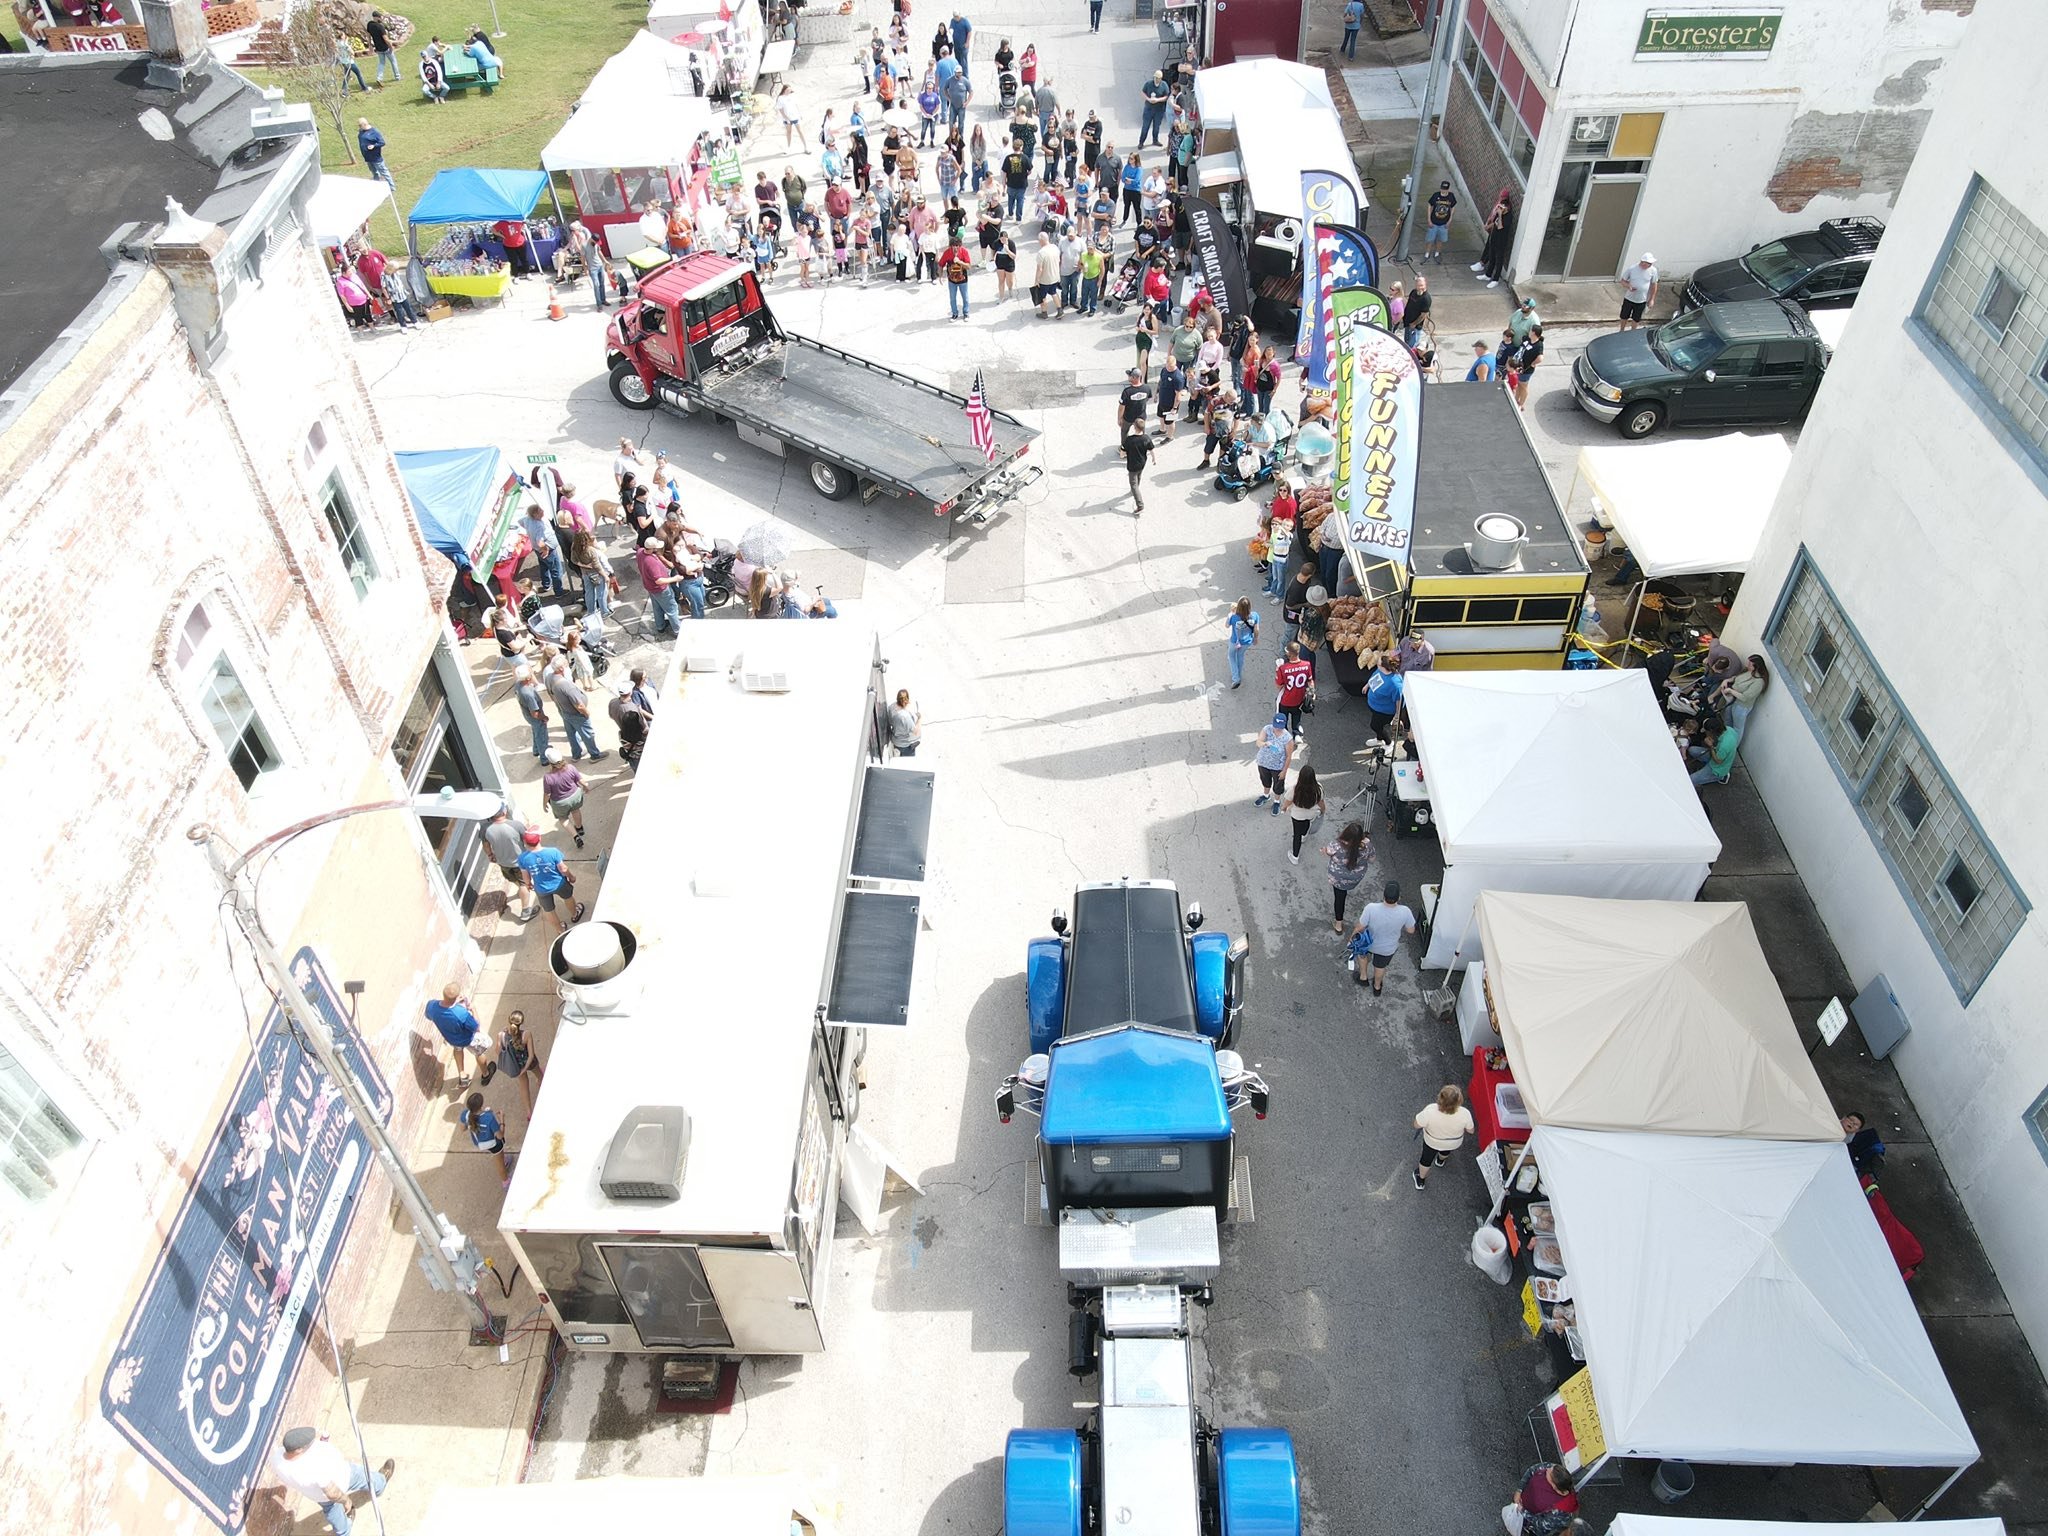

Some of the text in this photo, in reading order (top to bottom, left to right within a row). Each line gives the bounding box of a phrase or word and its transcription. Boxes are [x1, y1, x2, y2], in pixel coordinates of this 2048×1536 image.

[73, 36, 125, 51] KKBL
[1645, 17, 1773, 45] Forester's
[1193, 210, 1230, 315] CRAFT SNACK STICKS
[1337, 303, 1381, 336] DEEP
[1363, 371, 1400, 522] FUNNEL
[1351, 521, 1408, 548] CAKES
[1286, 673, 1307, 690] 30
[320, 1115, 346, 1164] 2016
[210, 1048, 320, 1416] COLEMAN VAU
[204, 1253, 237, 1313] THE
[1579, 1380, 1603, 1444] PANCAKES
